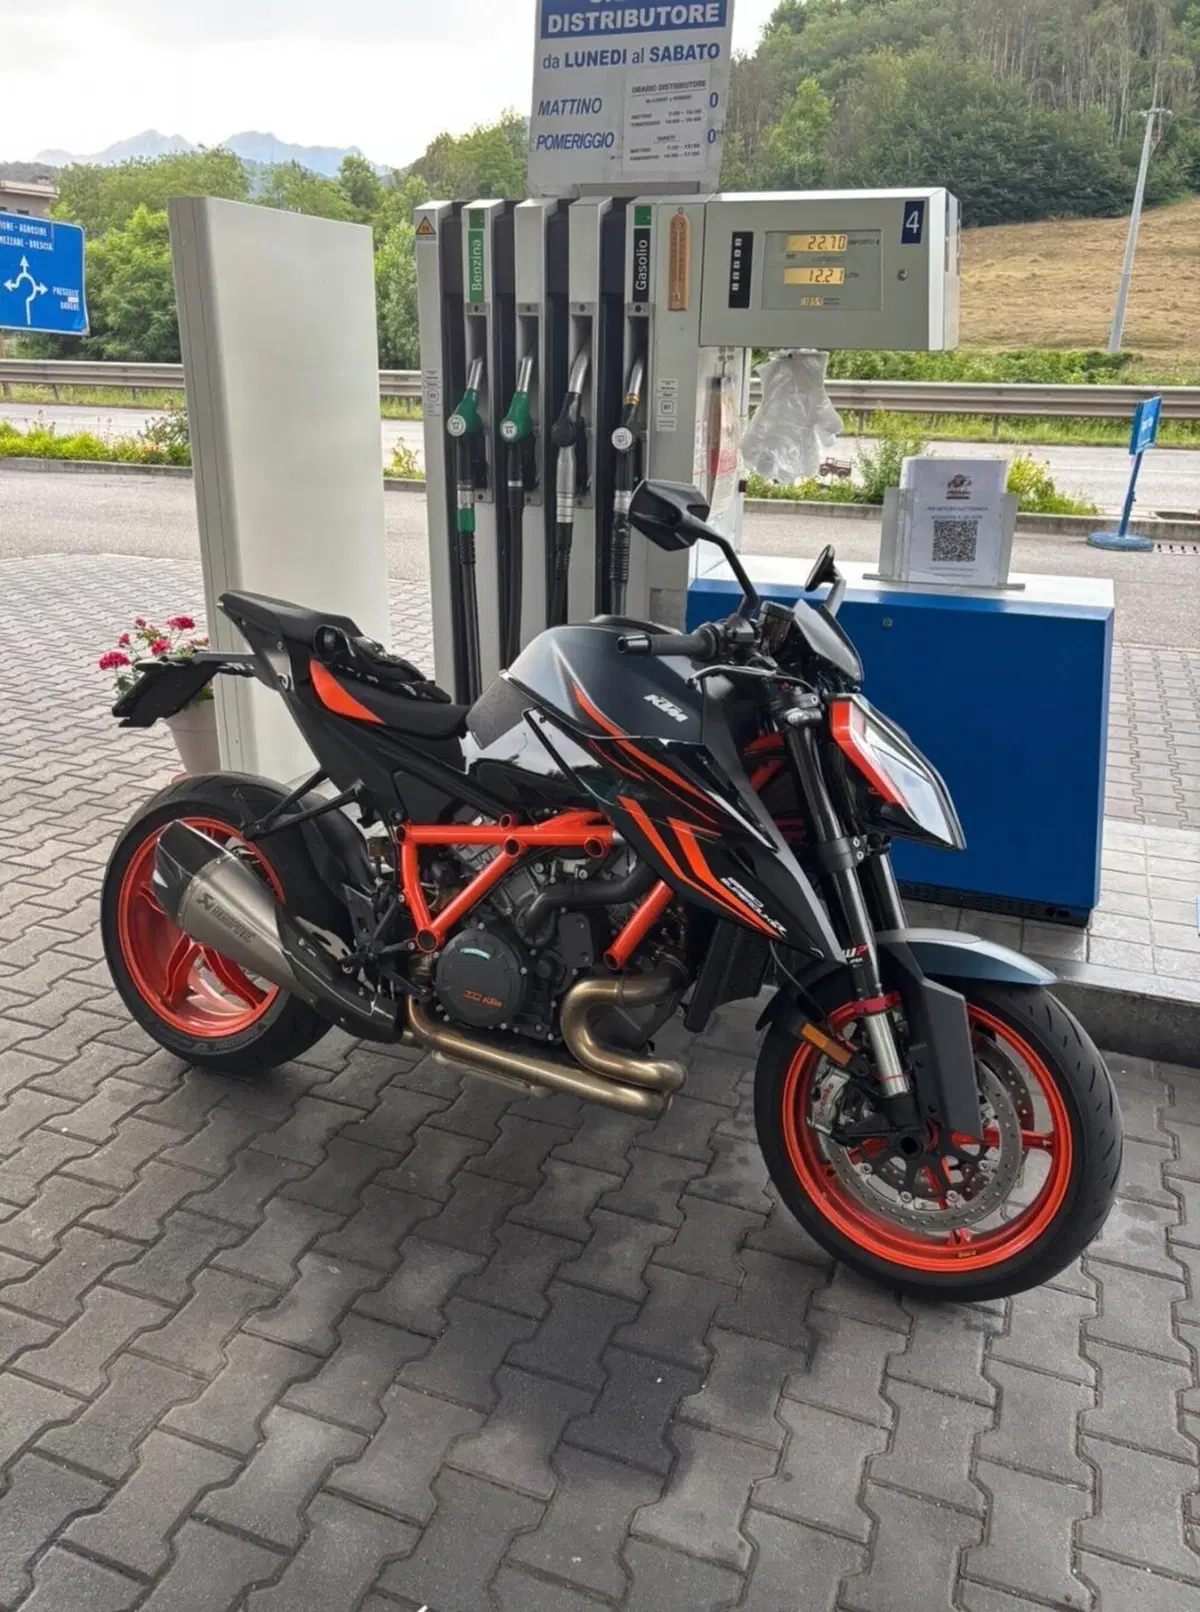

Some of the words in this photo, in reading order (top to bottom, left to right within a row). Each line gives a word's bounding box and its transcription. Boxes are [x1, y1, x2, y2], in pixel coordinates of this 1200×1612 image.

[548, 3, 720, 33] DISTRIBUTORE
[543, 54, 560, 69] da
[564, 49, 627, 68] LUNEDI
[631, 47, 645, 64] al
[649, 43, 720, 63] SABATO
[538, 98, 603, 116] MATTINO
[536, 132, 615, 150] POMERIGGIO
[905, 211, 920, 234] 4
[29, 240, 54, 252] BRESCIA
[808, 236, 846, 250] 22.70
[471, 239, 483, 291] Benzina
[635, 240, 649, 291] Gasolio
[808, 269, 844, 283] 12.21
[643, 694, 688, 722] KTM
[842, 944, 869, 958] WP
